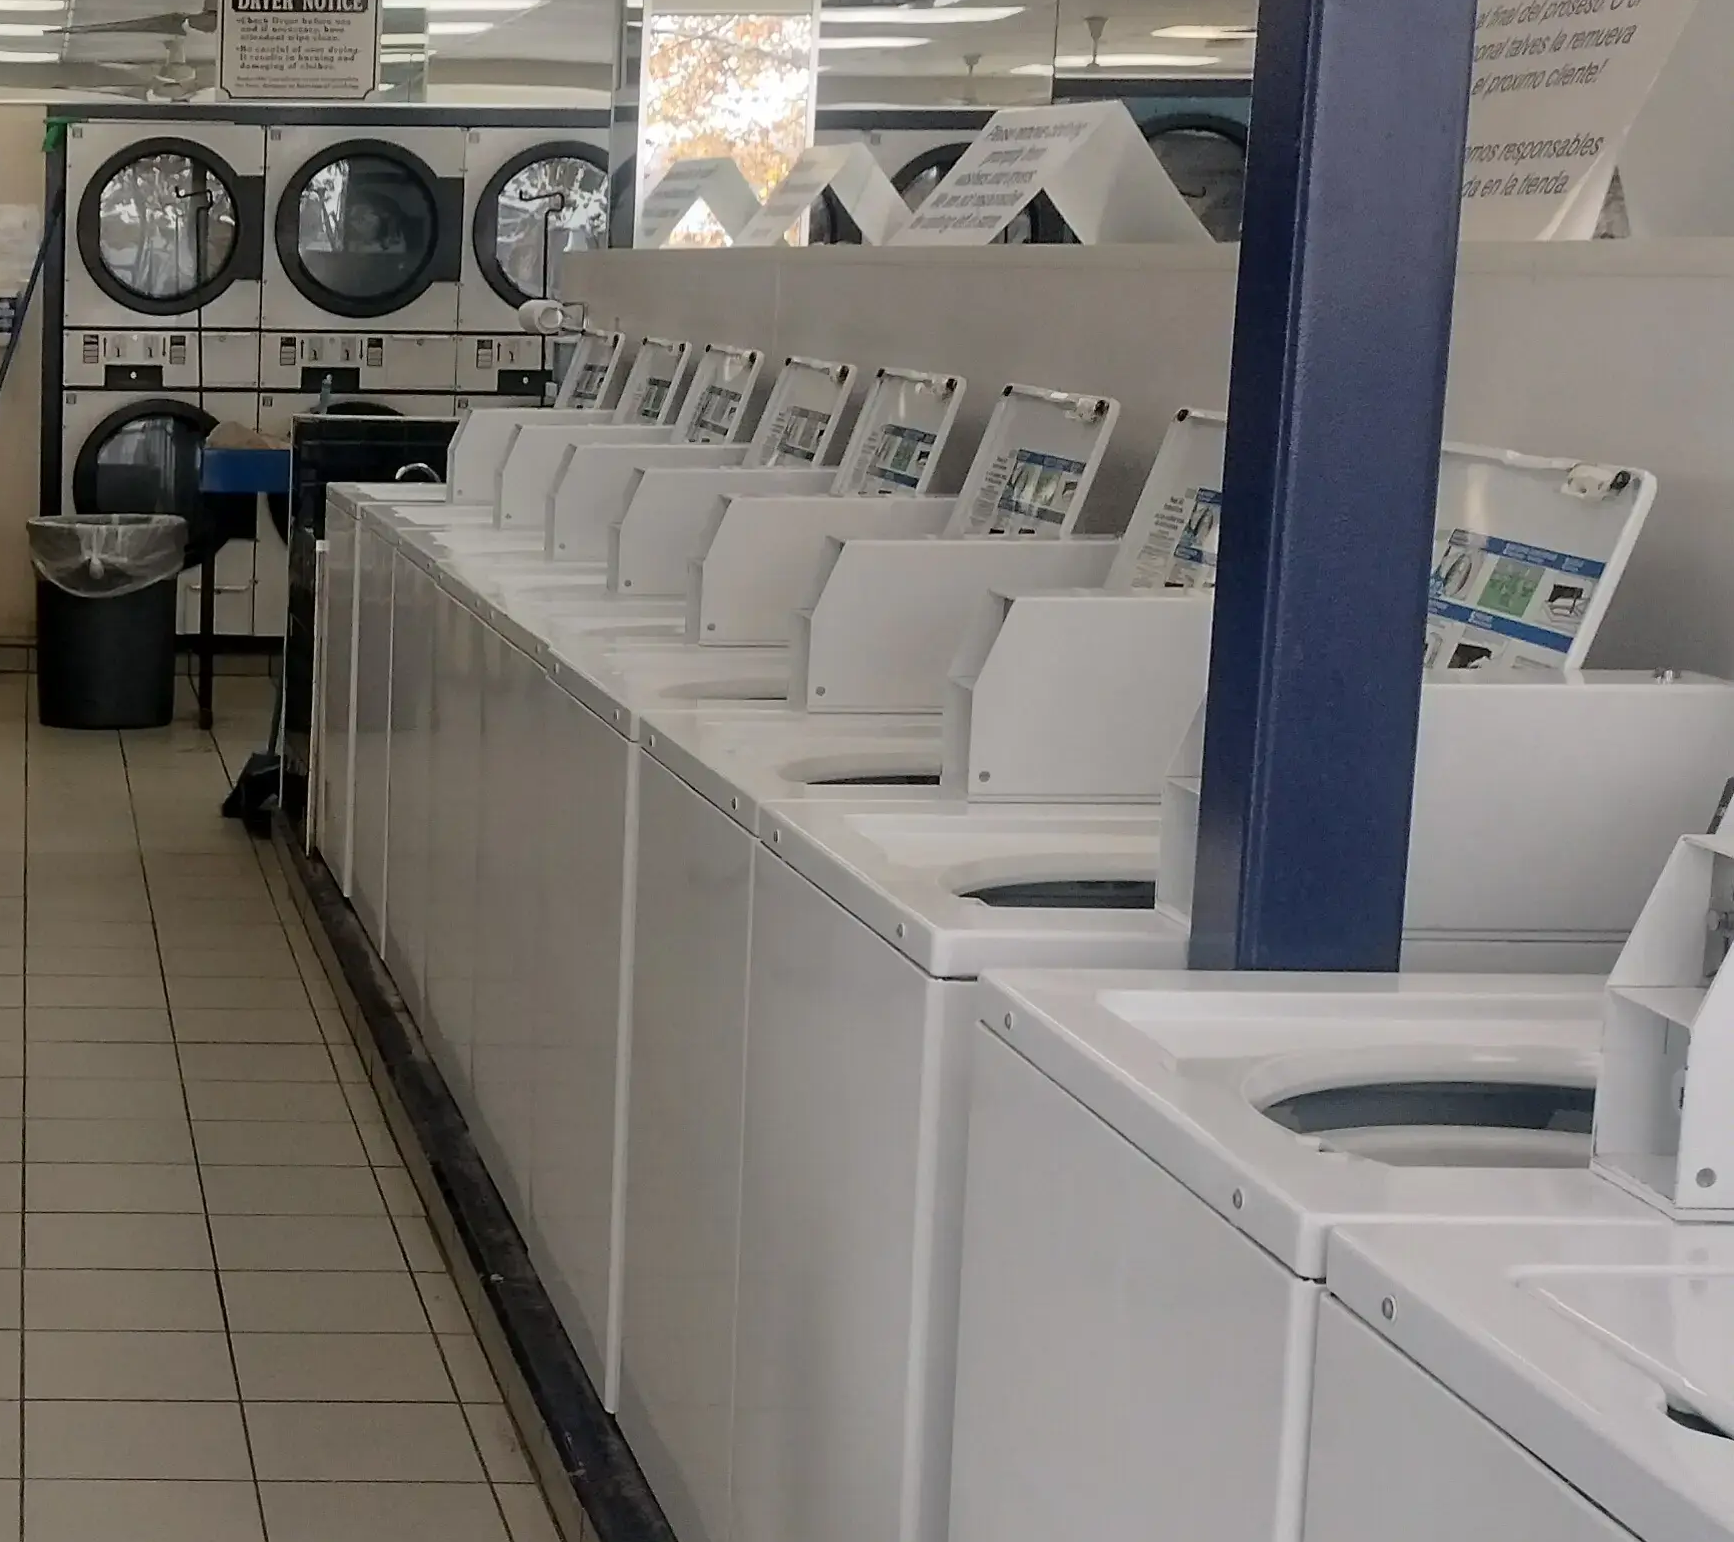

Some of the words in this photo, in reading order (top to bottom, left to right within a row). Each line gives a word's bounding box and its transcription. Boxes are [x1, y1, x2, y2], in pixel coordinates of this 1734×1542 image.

[1550, 28, 1568, 53] la
[1566, 24, 1637, 51] remueva
[1482, 68, 1546, 101] proximo
[1545, 58, 1609, 88] cliente!
[1497, 131, 1604, 166] responsables
[1480, 177, 1503, 198] en
[1499, 171, 1520, 196] la
